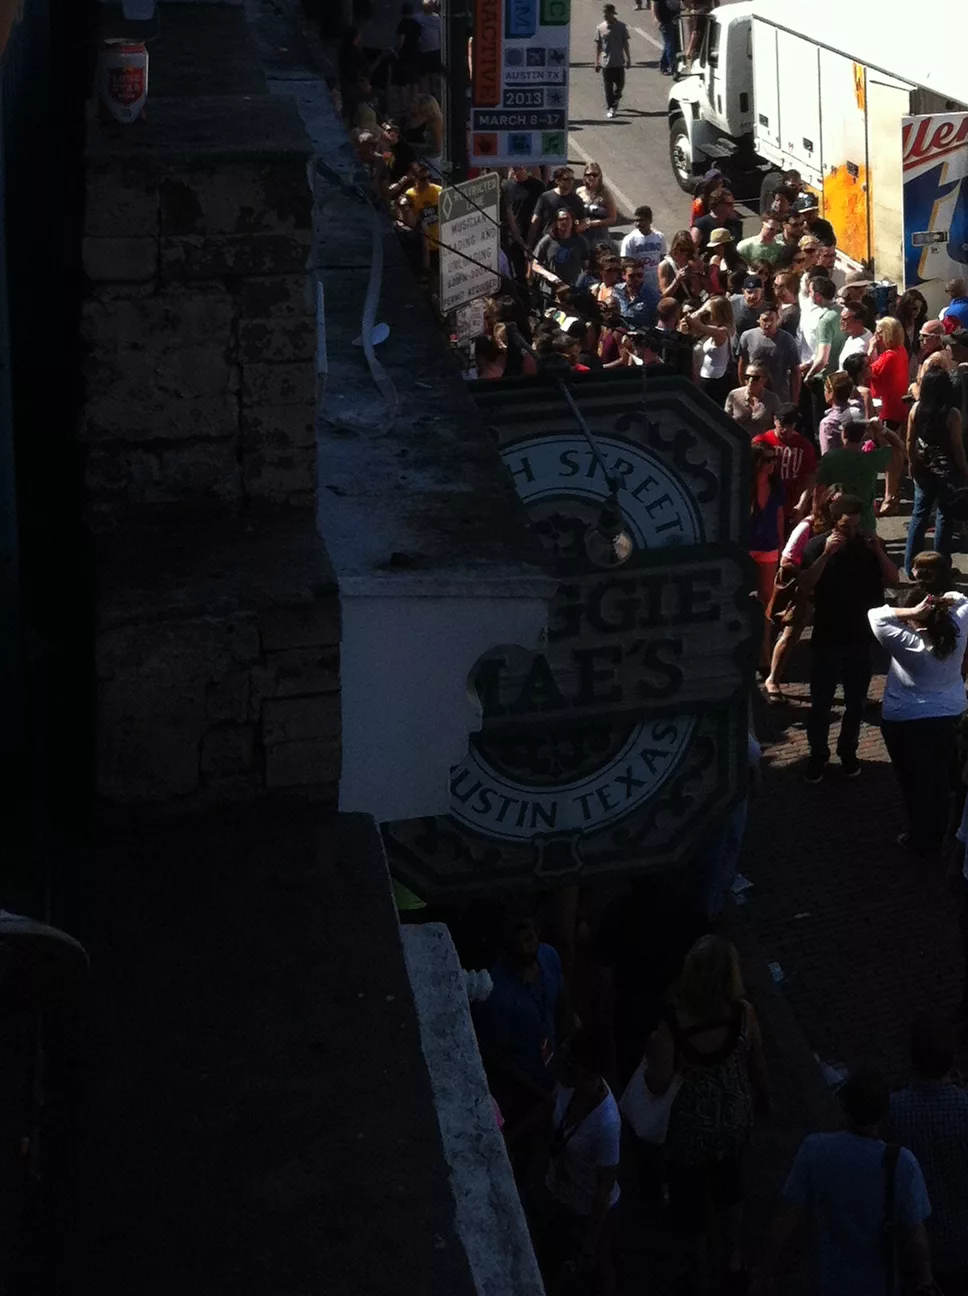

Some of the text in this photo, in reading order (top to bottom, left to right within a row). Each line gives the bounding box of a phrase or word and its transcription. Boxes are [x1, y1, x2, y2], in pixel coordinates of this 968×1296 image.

[505, 71, 560, 80] AUSTIN TX
[506, 92, 542, 105] 2013
[479, 115, 526, 126] MARCH
[559, 450, 684, 534] STREET
[450, 722, 679, 829] USTIN TEXAS
